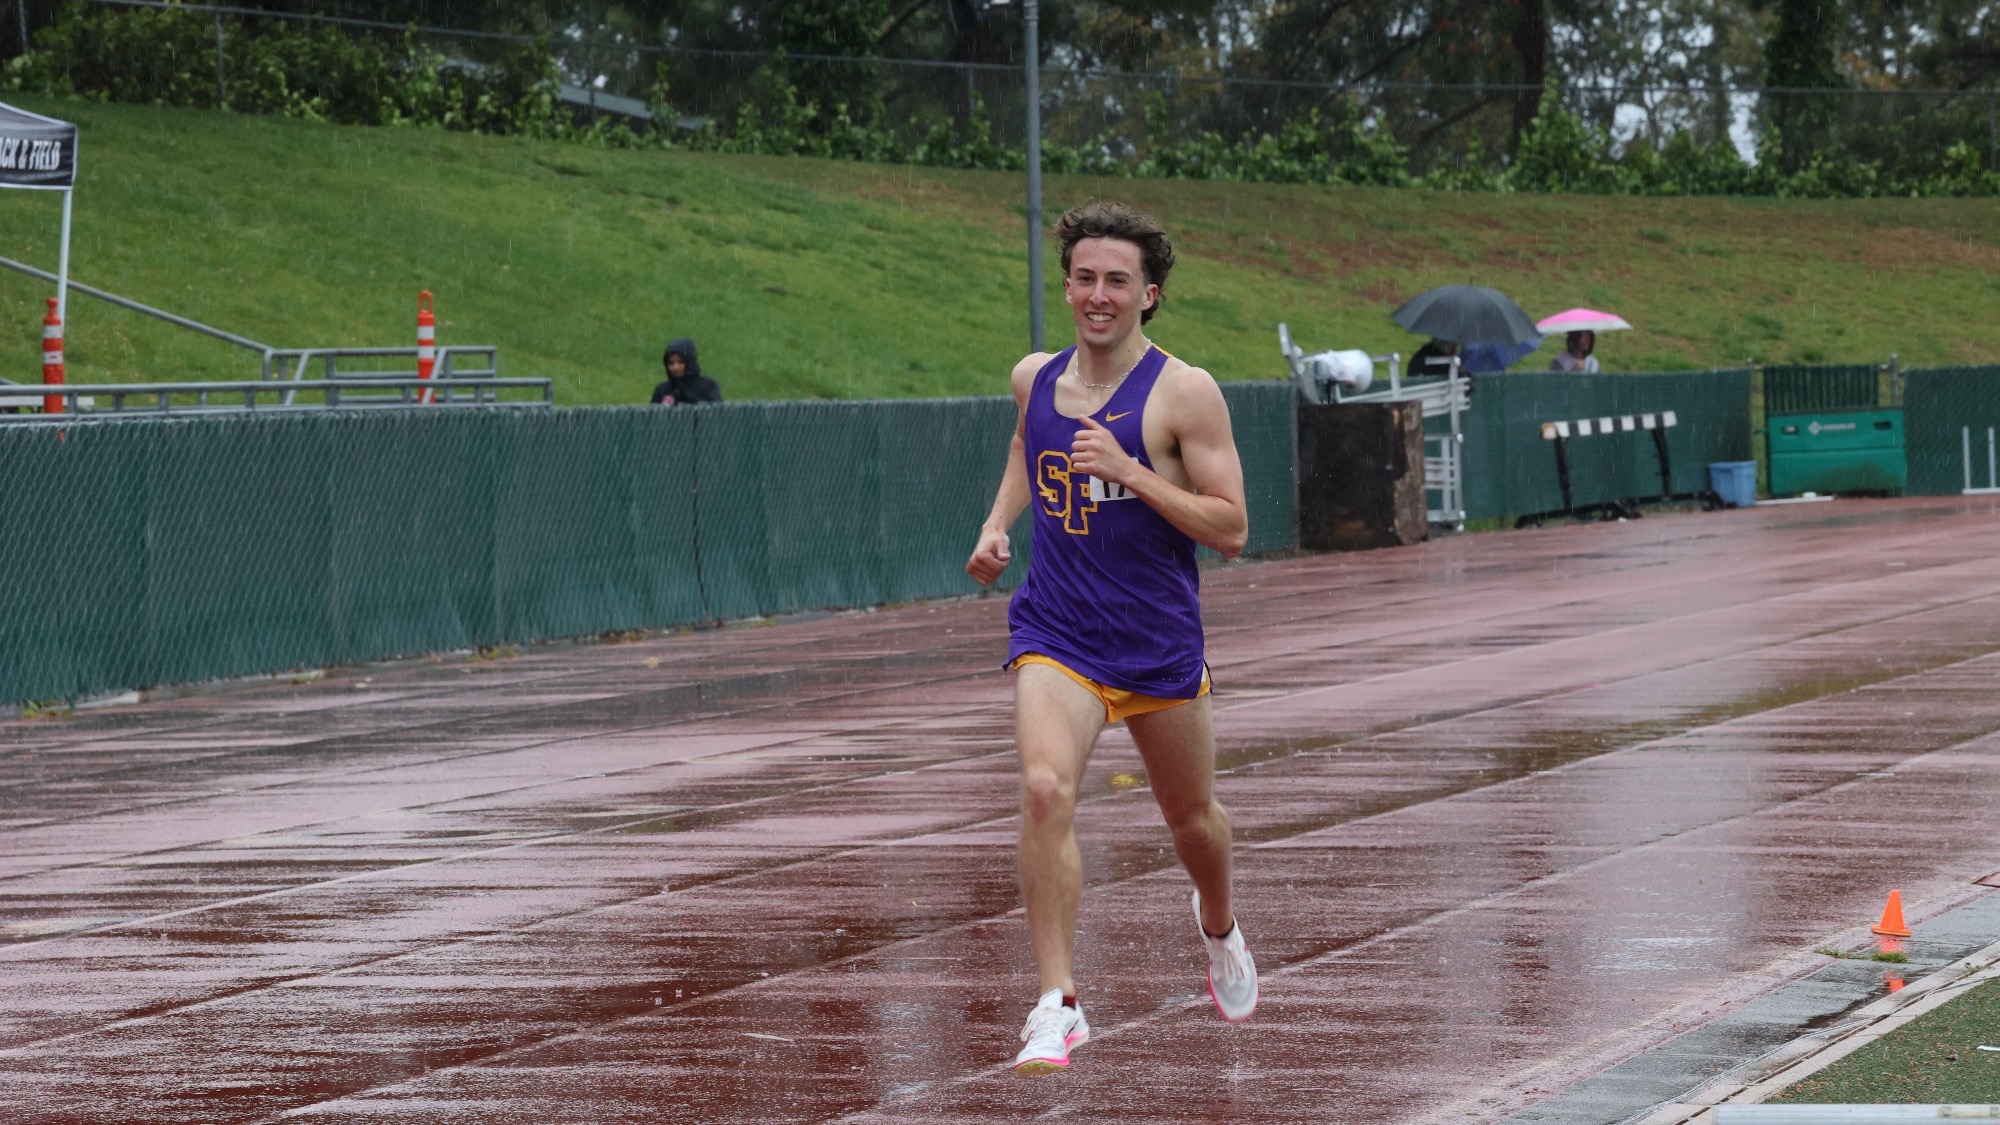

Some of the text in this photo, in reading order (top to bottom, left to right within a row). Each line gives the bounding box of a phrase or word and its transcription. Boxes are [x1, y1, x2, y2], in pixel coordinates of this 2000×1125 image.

[18, 139, 29, 170] &
[29, 140, 62, 171] FIELD
[1036, 449, 1098, 535] SF
